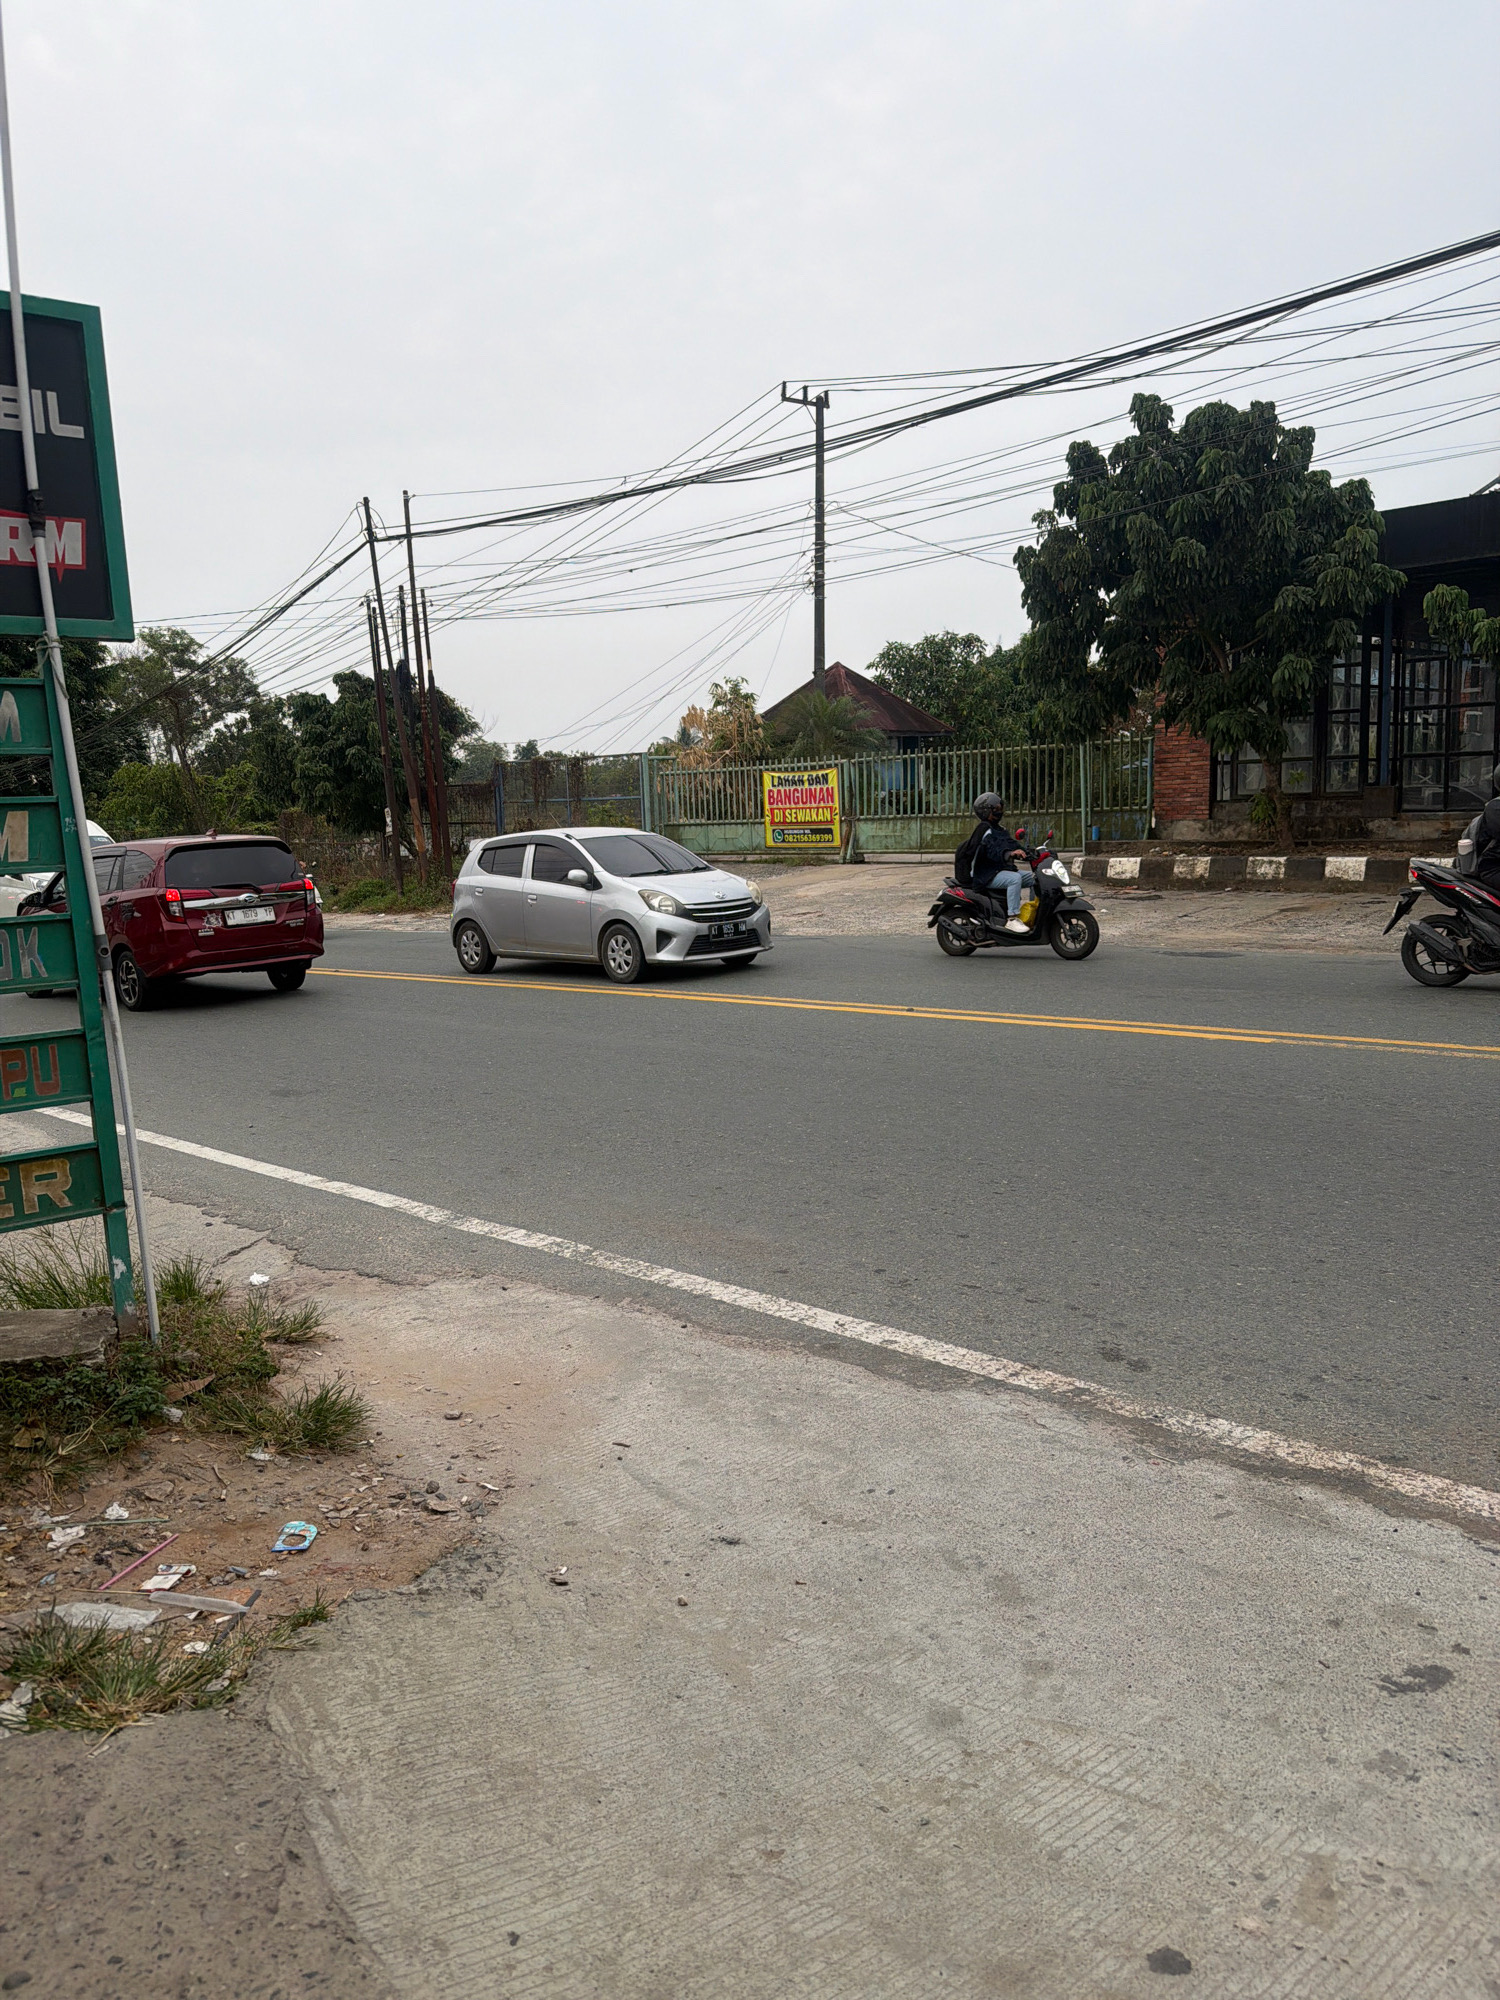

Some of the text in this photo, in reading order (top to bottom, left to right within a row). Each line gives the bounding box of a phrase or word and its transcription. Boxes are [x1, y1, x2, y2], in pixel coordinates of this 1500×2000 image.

[772, 773, 828, 787] LAHAN DAN
[768, 787, 834, 805] BANGUNAN
[774, 808, 831, 822] DI SEWAKAN
[226, 911, 235, 920] KT
[264, 908, 273, 916] YP
